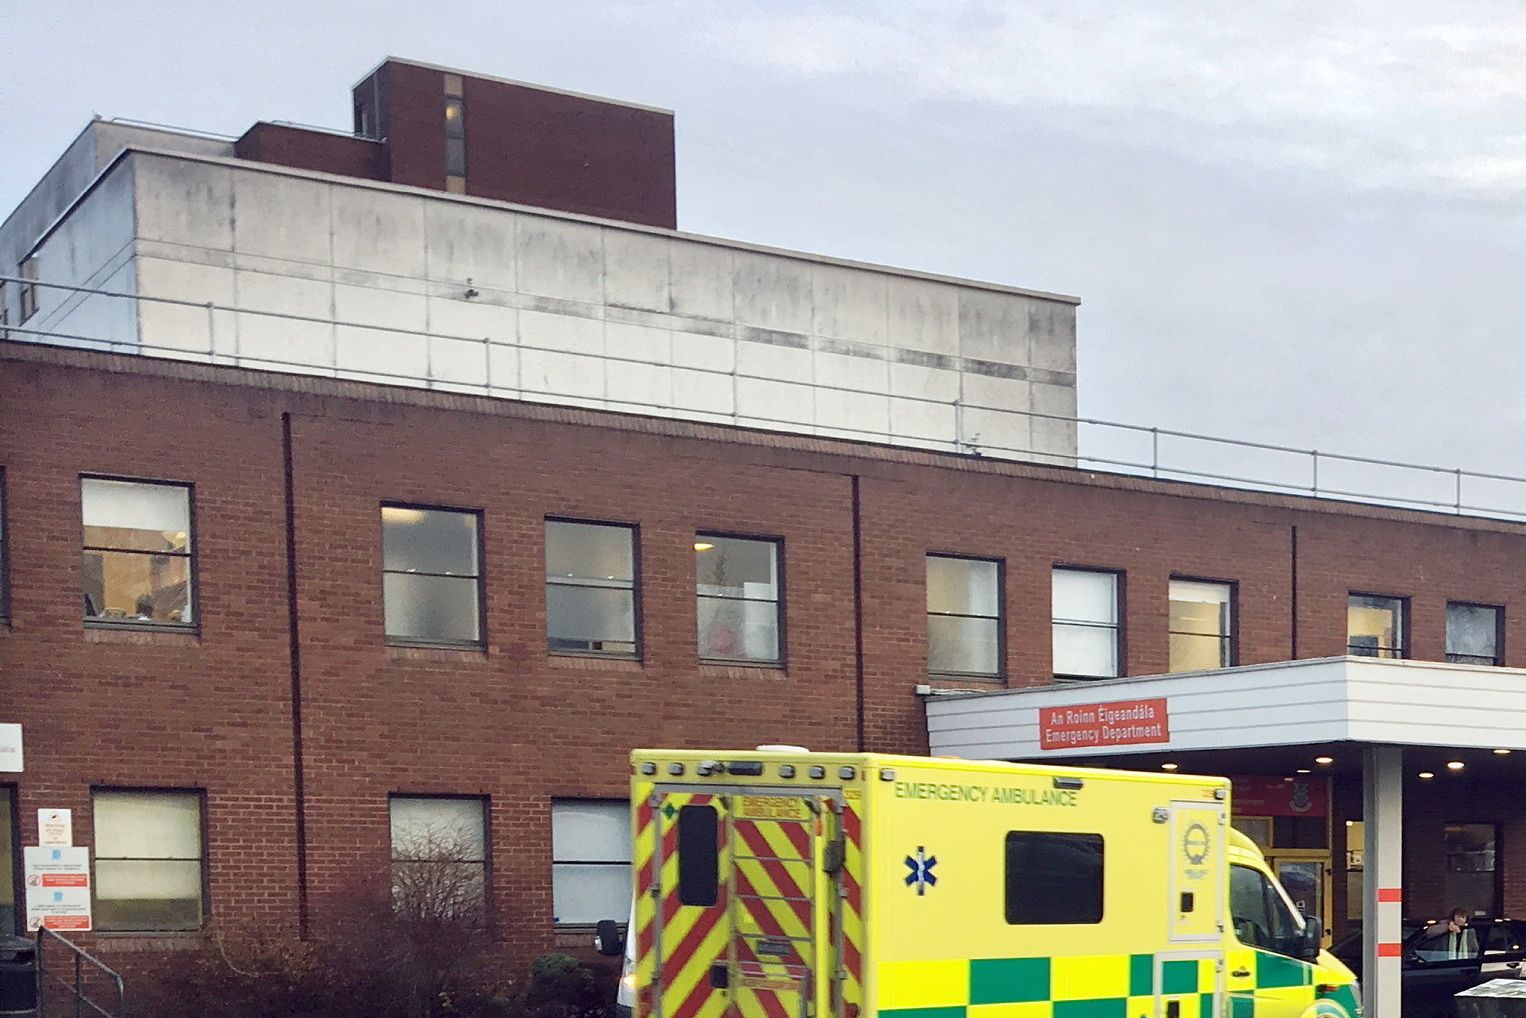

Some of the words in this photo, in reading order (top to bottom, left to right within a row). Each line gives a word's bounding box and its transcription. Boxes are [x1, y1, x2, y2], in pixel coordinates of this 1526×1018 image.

[1051, 712, 1063, 726] An
[1066, 710, 1095, 725] Roinn
[1098, 705, 1155, 725] Éigeandála
[1045, 728, 1099, 744] Emergency
[1102, 724, 1162, 742] Department
[742, 796, 798, 807] EMERGENCY
[895, 781, 989, 802] EMERGENCY
[991, 787, 1078, 807] AMBULANCE
[743, 807, 802, 818] AMBULANCE
